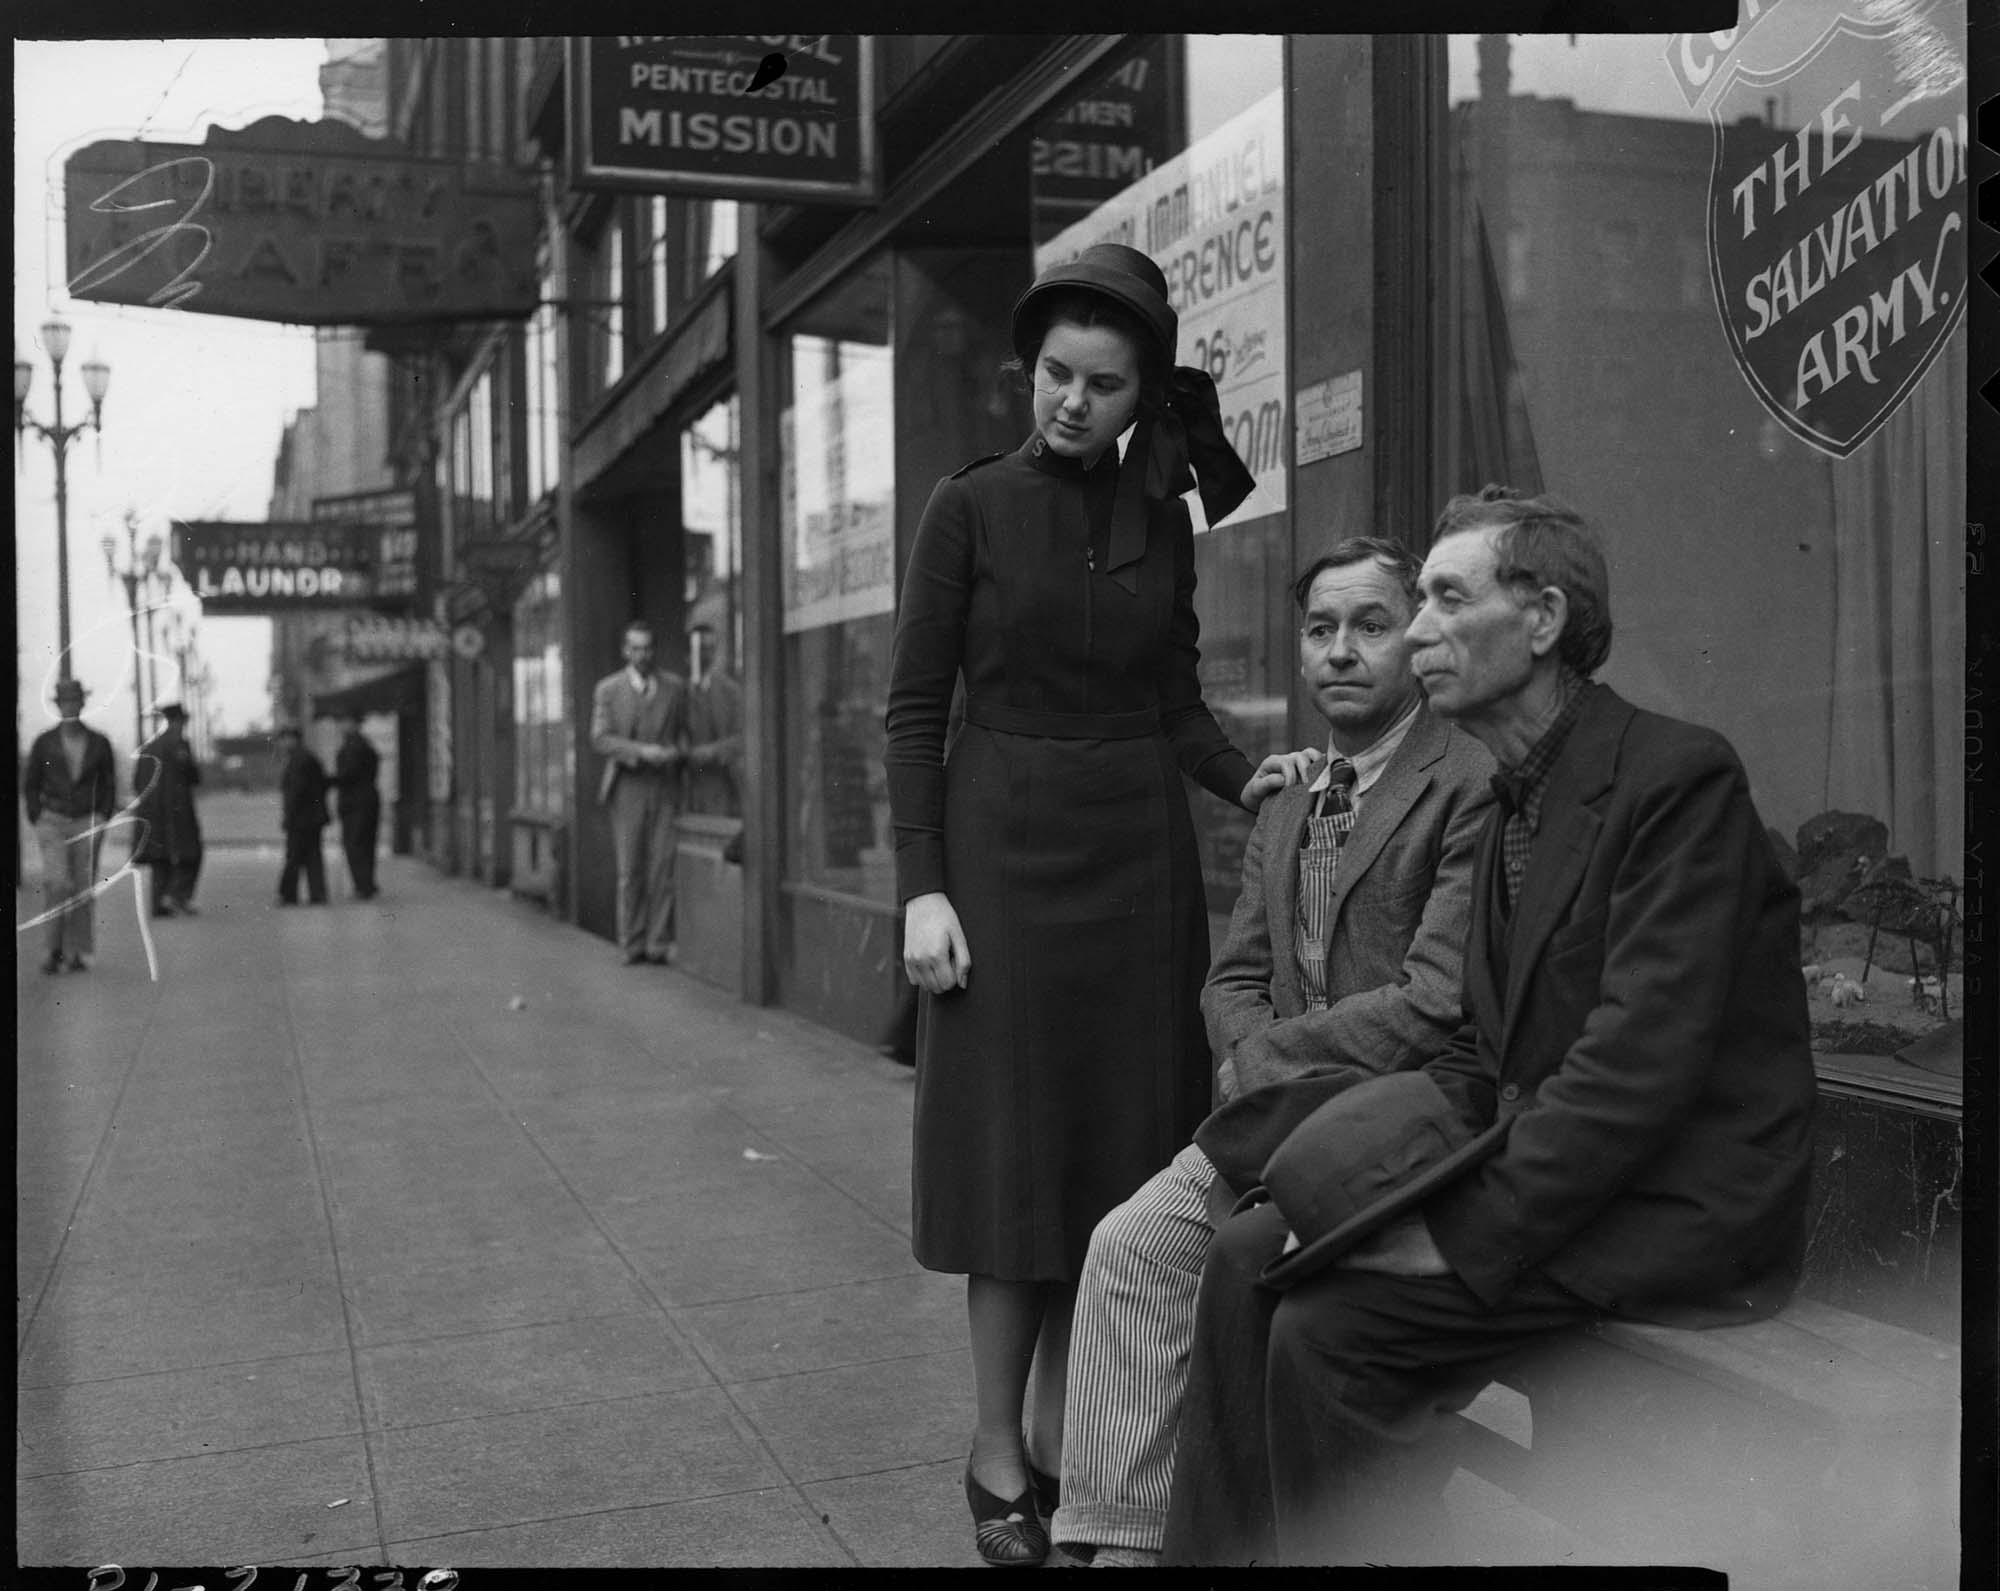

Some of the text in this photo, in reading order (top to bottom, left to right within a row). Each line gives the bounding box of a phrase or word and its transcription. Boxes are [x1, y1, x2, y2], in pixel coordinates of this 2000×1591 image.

[631, 63, 838, 104] PENTECSTAL
[619, 107, 838, 158] MISSION
[1732, 80, 1863, 240] THE
[1163, 210, 1276, 314] ERENCE
[1031, 438, 1047, 457] S
[236, 539, 328, 565] HAND
